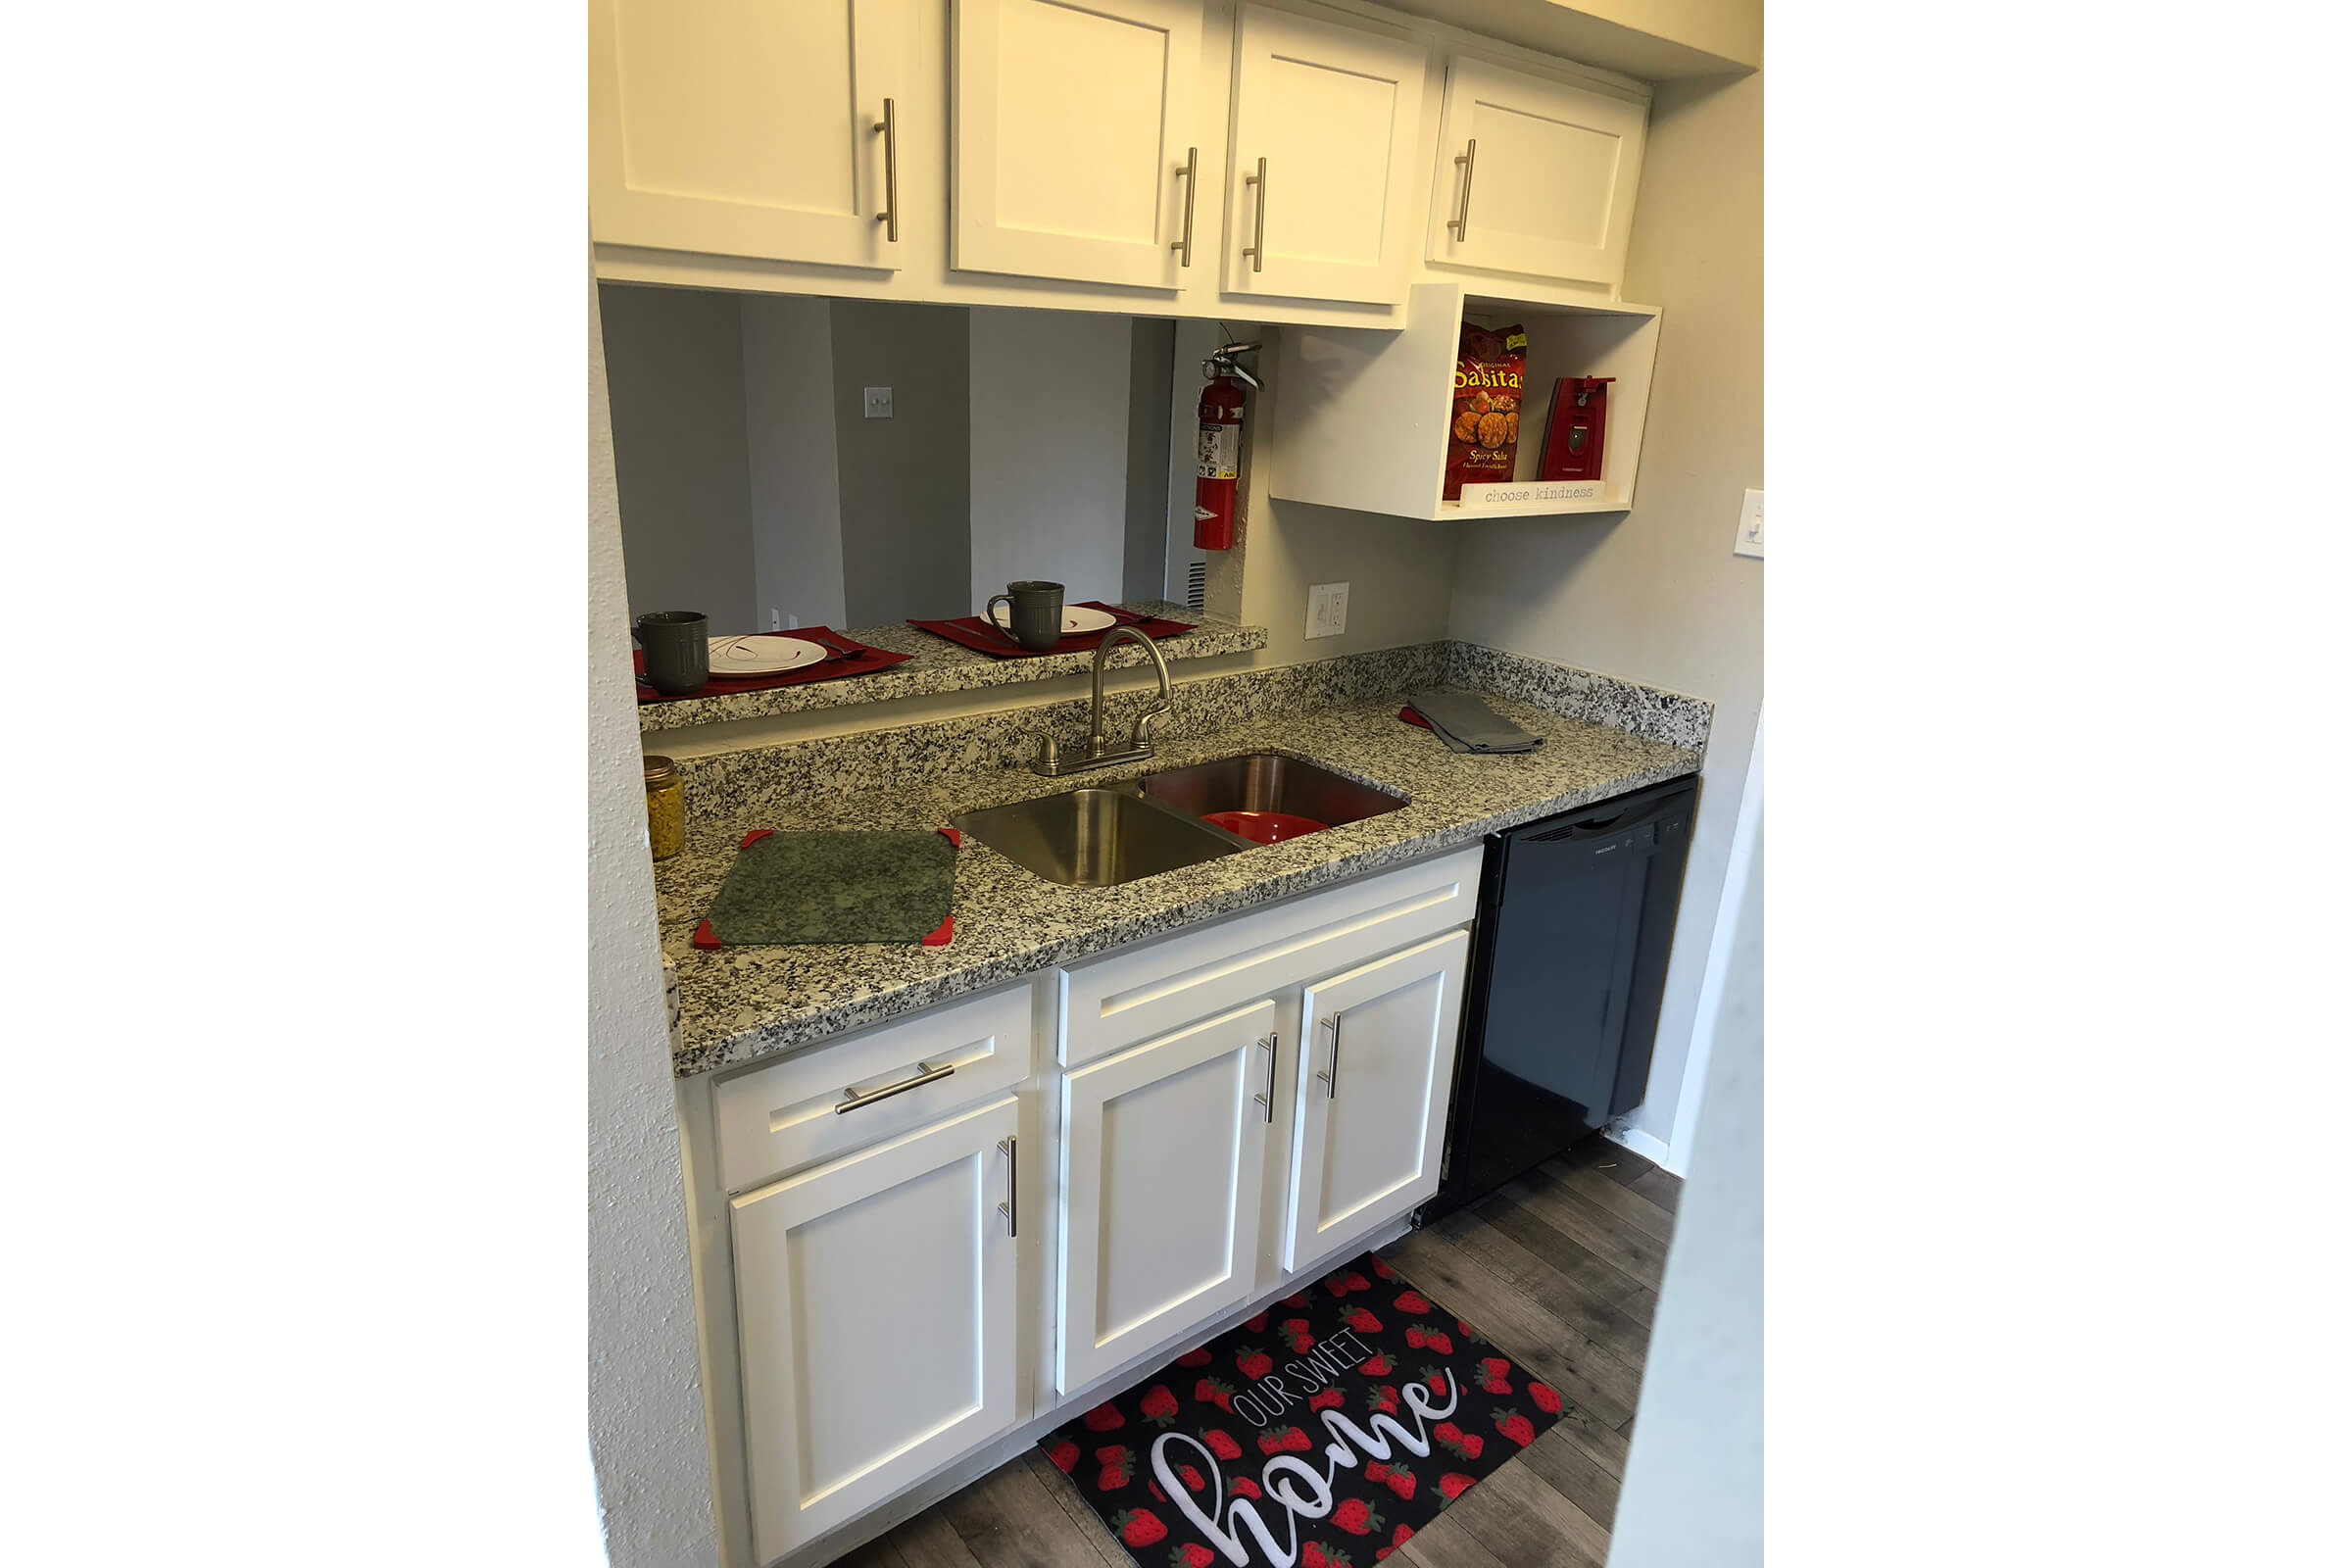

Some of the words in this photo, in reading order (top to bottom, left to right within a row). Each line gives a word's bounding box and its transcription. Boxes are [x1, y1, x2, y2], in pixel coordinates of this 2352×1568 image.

[1485, 488, 1530, 503] choose
[1535, 485, 1594, 501] kindness
[1233, 1375, 1303, 1427] OUR
[1284, 1327, 1373, 1394] SWEET
[1151, 1367, 1458, 1568] home
